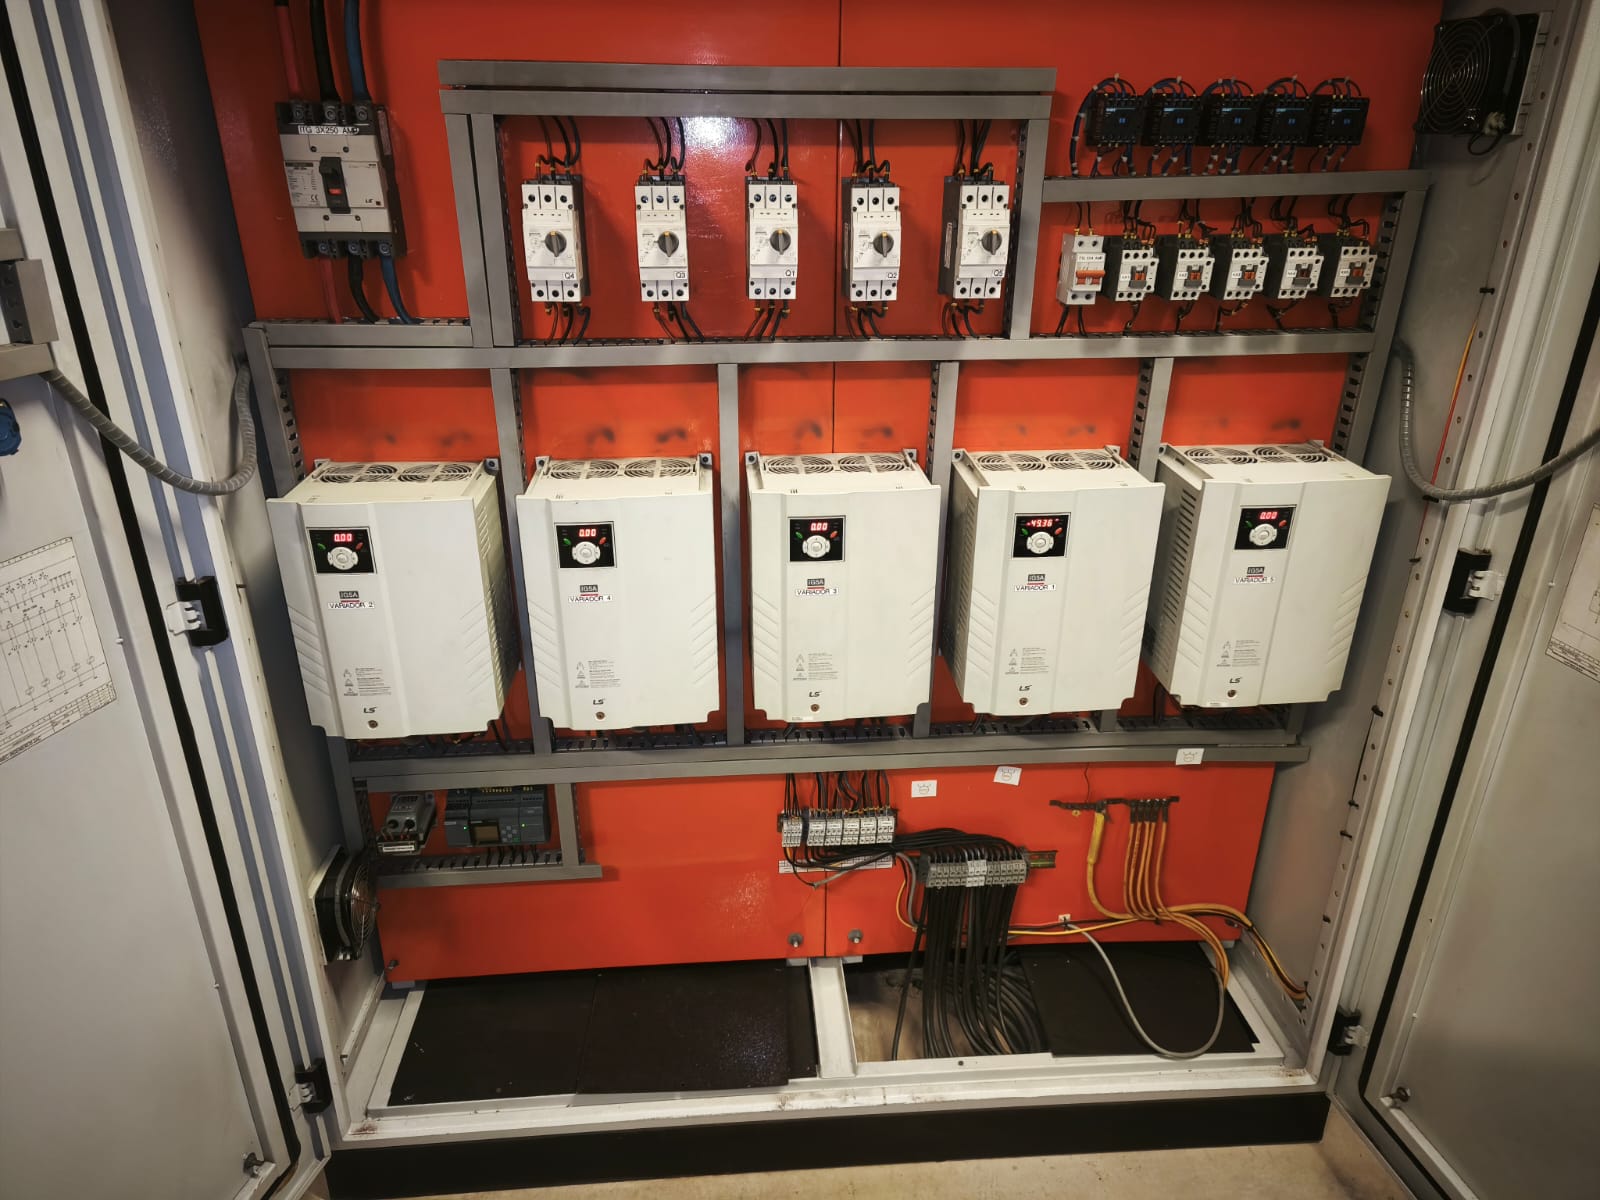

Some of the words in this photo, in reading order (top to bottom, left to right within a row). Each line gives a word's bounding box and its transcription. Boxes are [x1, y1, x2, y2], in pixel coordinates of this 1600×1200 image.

[1229, 676, 1242, 684] LS
[1018, 684, 1032, 692] LS
[808, 690, 822, 698] LS
[363, 706, 377, 714] LS
